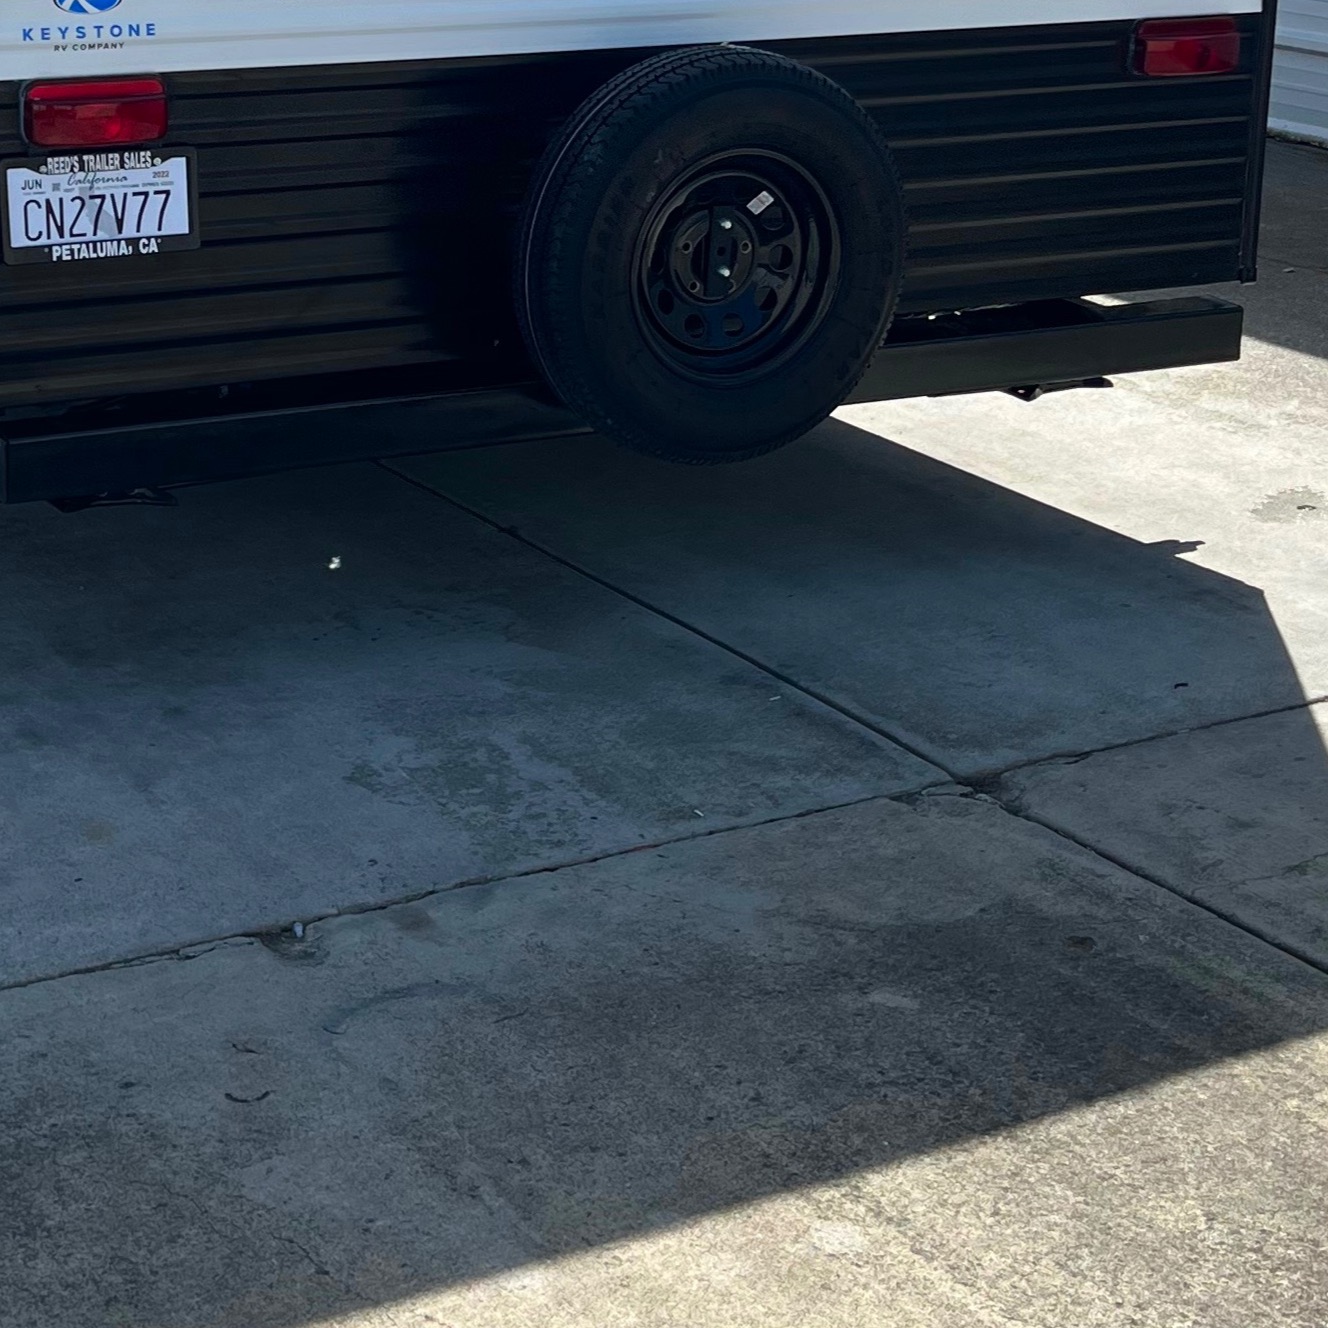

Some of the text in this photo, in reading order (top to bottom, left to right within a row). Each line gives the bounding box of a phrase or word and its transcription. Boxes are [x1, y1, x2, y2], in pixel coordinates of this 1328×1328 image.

[22, 23, 156, 41] KEYSTONE
[54, 42, 125, 52] RV COMPANY
[46, 151, 152, 175] REED'S TRAILER SALES
[67, 172, 129, 190] California
[152, 171, 170, 179] 2022
[21, 179, 43, 191] JUN
[23, 189, 172, 242] CN27V77
[52, 238, 159, 262] PETALUMA, CA
